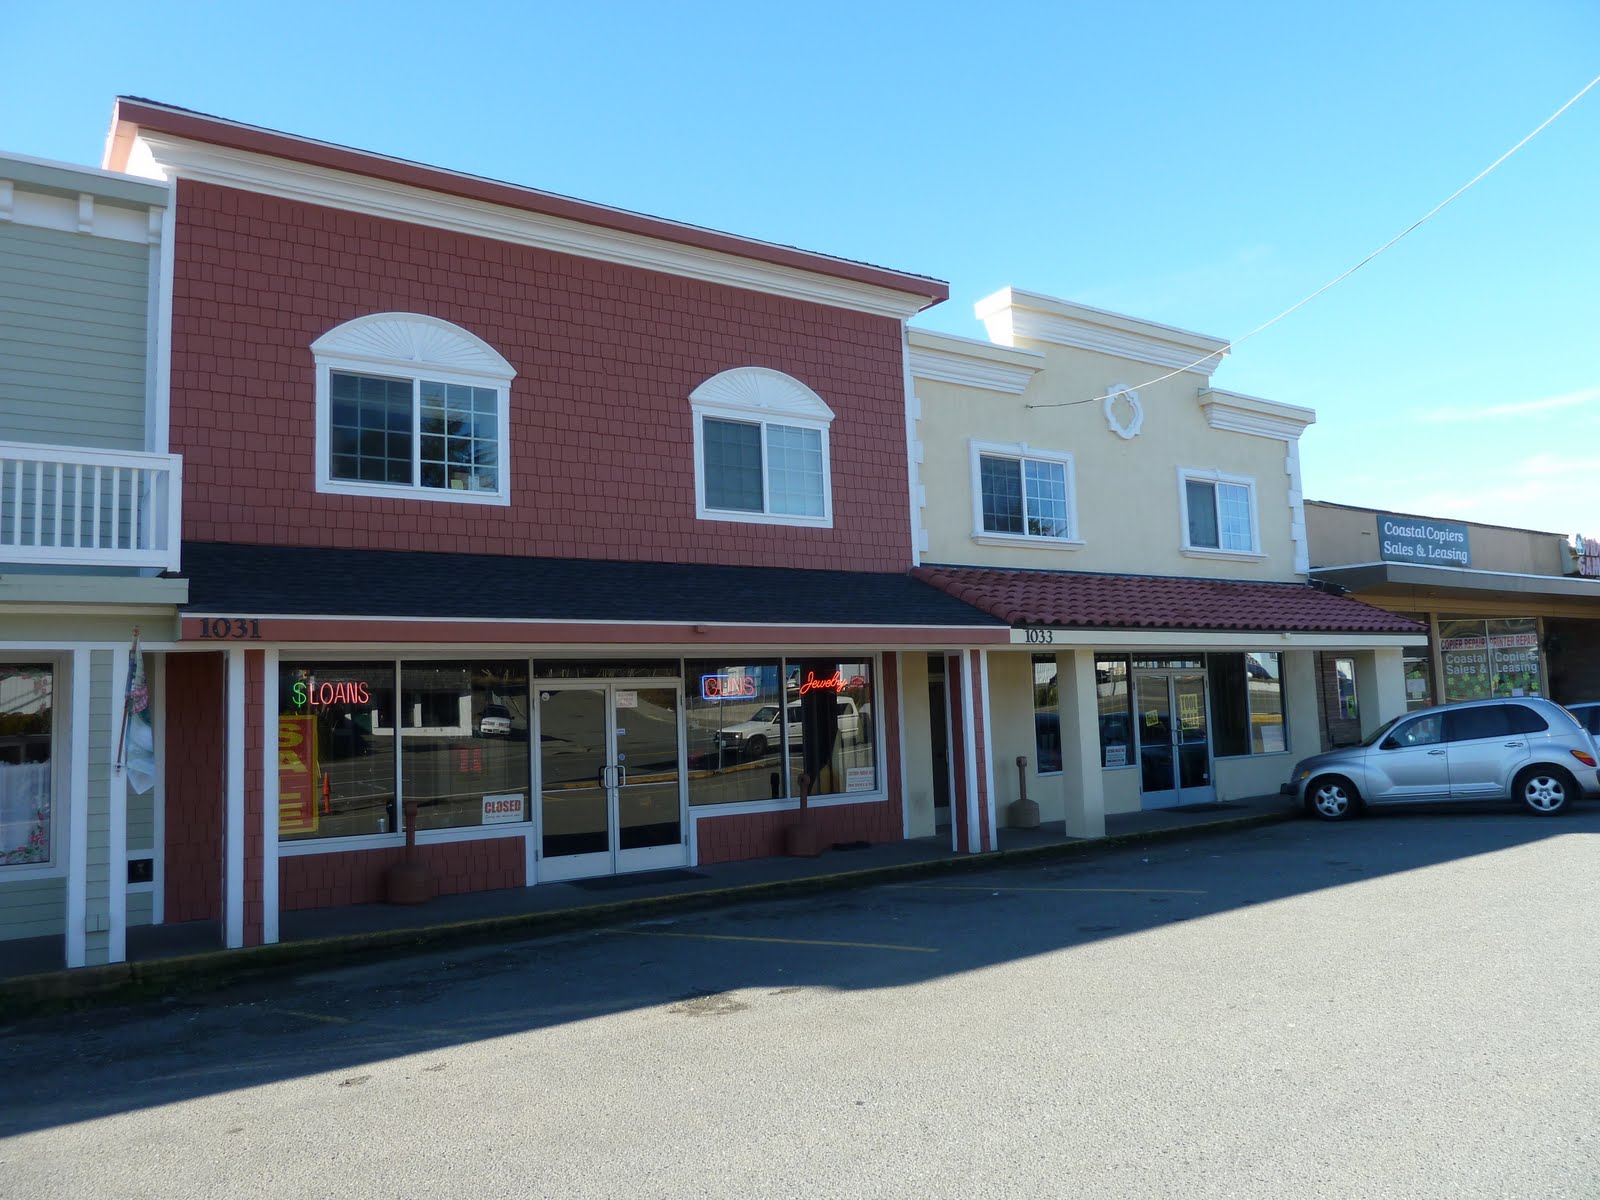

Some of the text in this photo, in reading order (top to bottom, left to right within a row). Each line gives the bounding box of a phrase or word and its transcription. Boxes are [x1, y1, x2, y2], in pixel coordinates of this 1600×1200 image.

[1384, 522, 1463, 544] Coastal Copiers
[1384, 541, 1467, 564] Sales & Leasing
[200, 618, 262, 638] 1031
[1025, 629, 1053, 643] 1033
[1441, 639, 1462, 650] COPIER
[1445, 653, 1487, 664] Coastal
[1446, 663, 1537, 674] Sales & Leasing
[705, 677, 755, 697] GUNS
[800, 671, 848, 694] Jewelry
[485, 800, 521, 814] CLOSED
